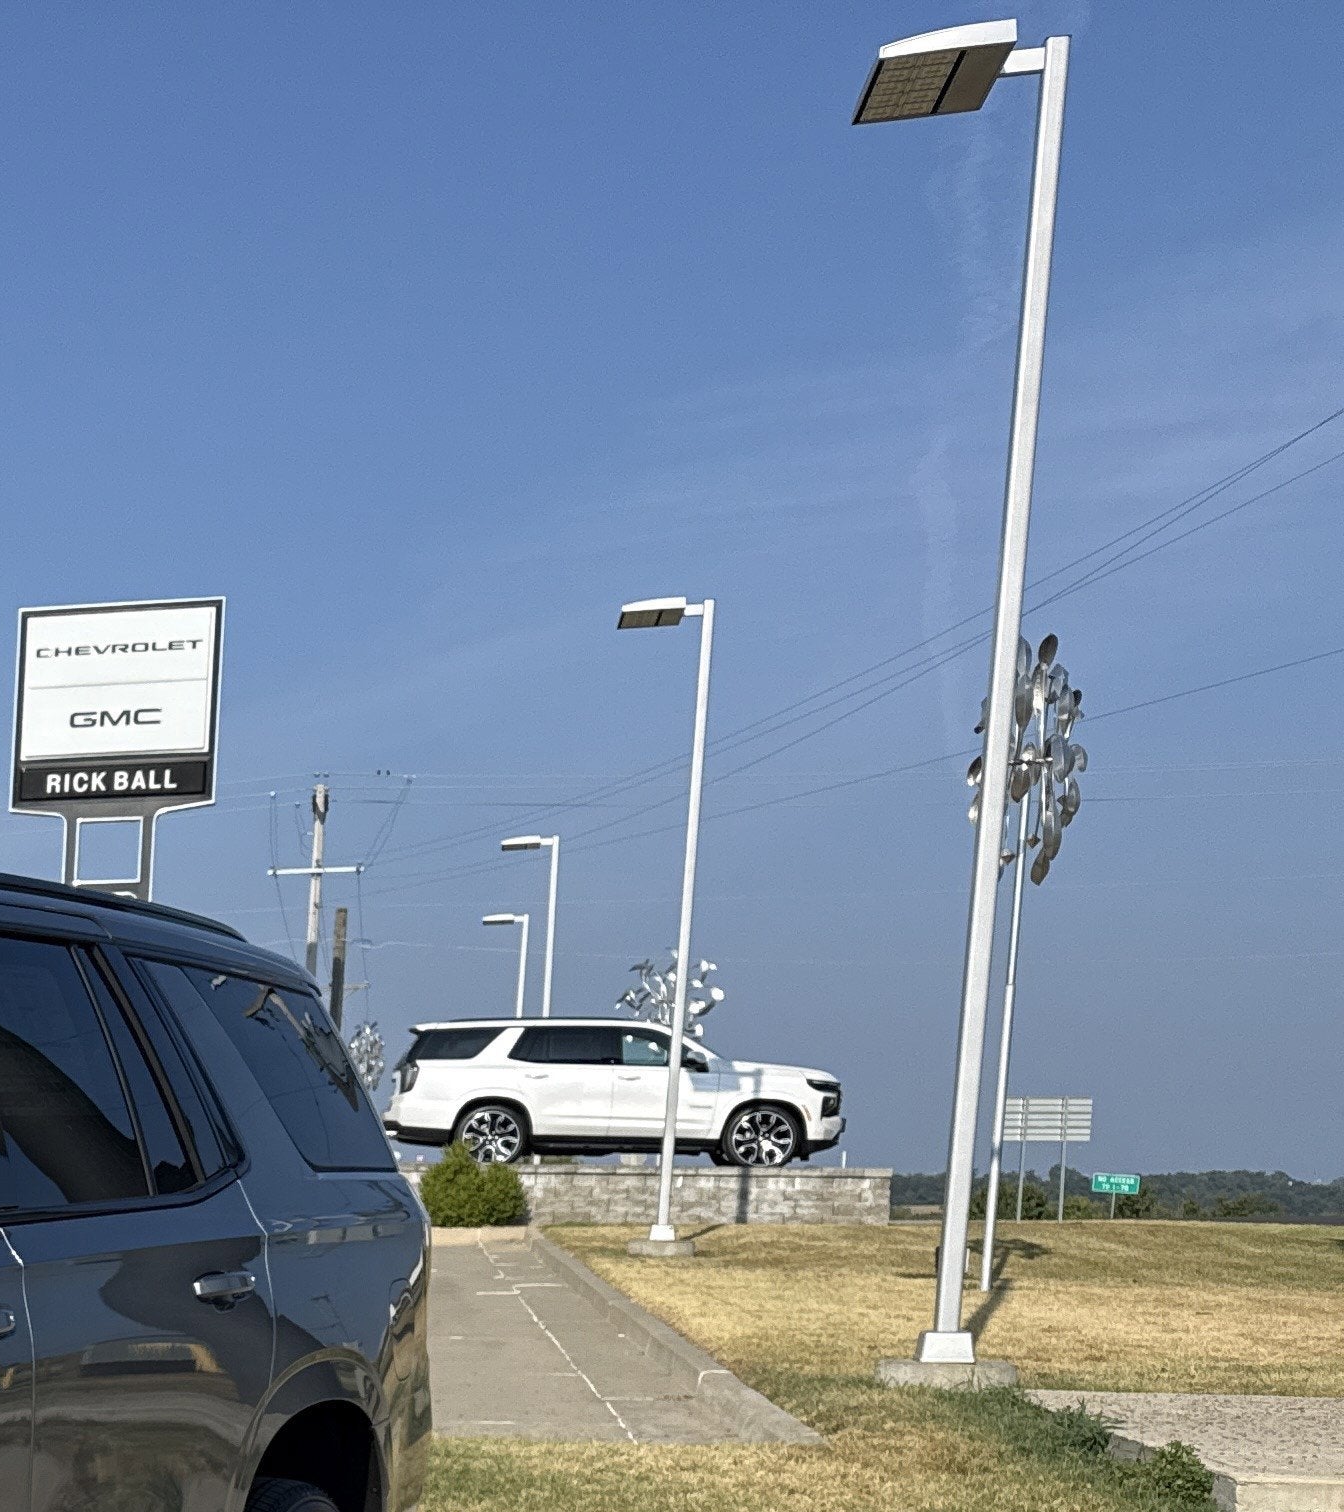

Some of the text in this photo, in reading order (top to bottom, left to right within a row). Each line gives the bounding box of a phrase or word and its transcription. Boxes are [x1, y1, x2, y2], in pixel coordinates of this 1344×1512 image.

[35, 639, 204, 659] CHEVROLET
[69, 708, 163, 728] GMC
[45, 769, 178, 794] RICK BALL
